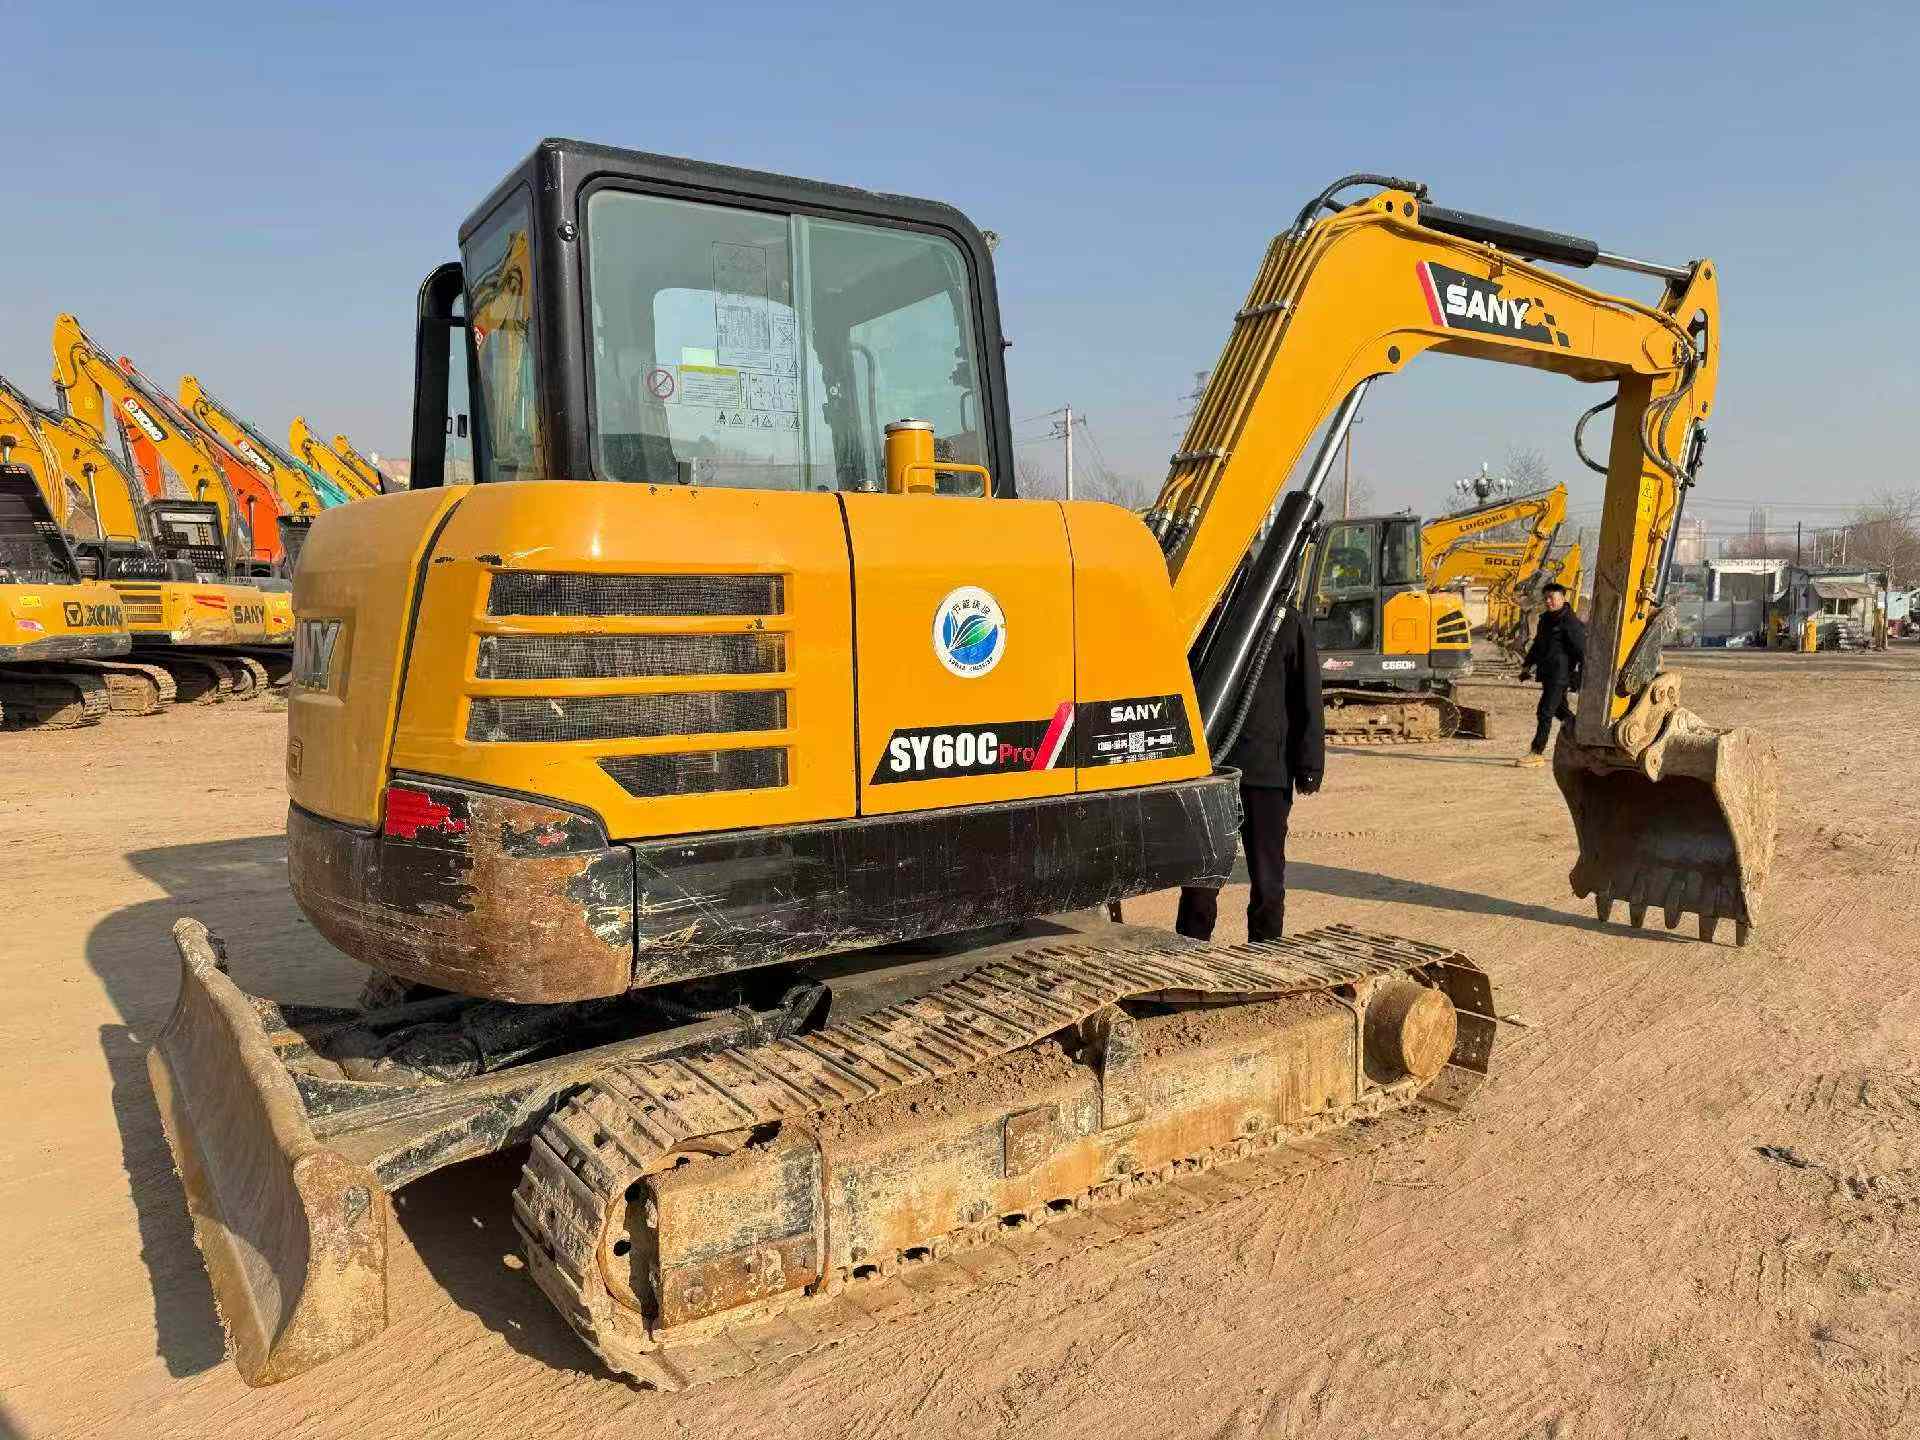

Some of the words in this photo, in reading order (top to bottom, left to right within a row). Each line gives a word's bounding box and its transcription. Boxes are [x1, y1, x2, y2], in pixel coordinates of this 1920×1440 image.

[1446, 282, 1529, 330] SANY
[234, 605, 264, 624] SANY
[1110, 703, 1163, 724] SANY
[889, 732, 998, 773] SY60C
[999, 743, 1036, 766] Pro
